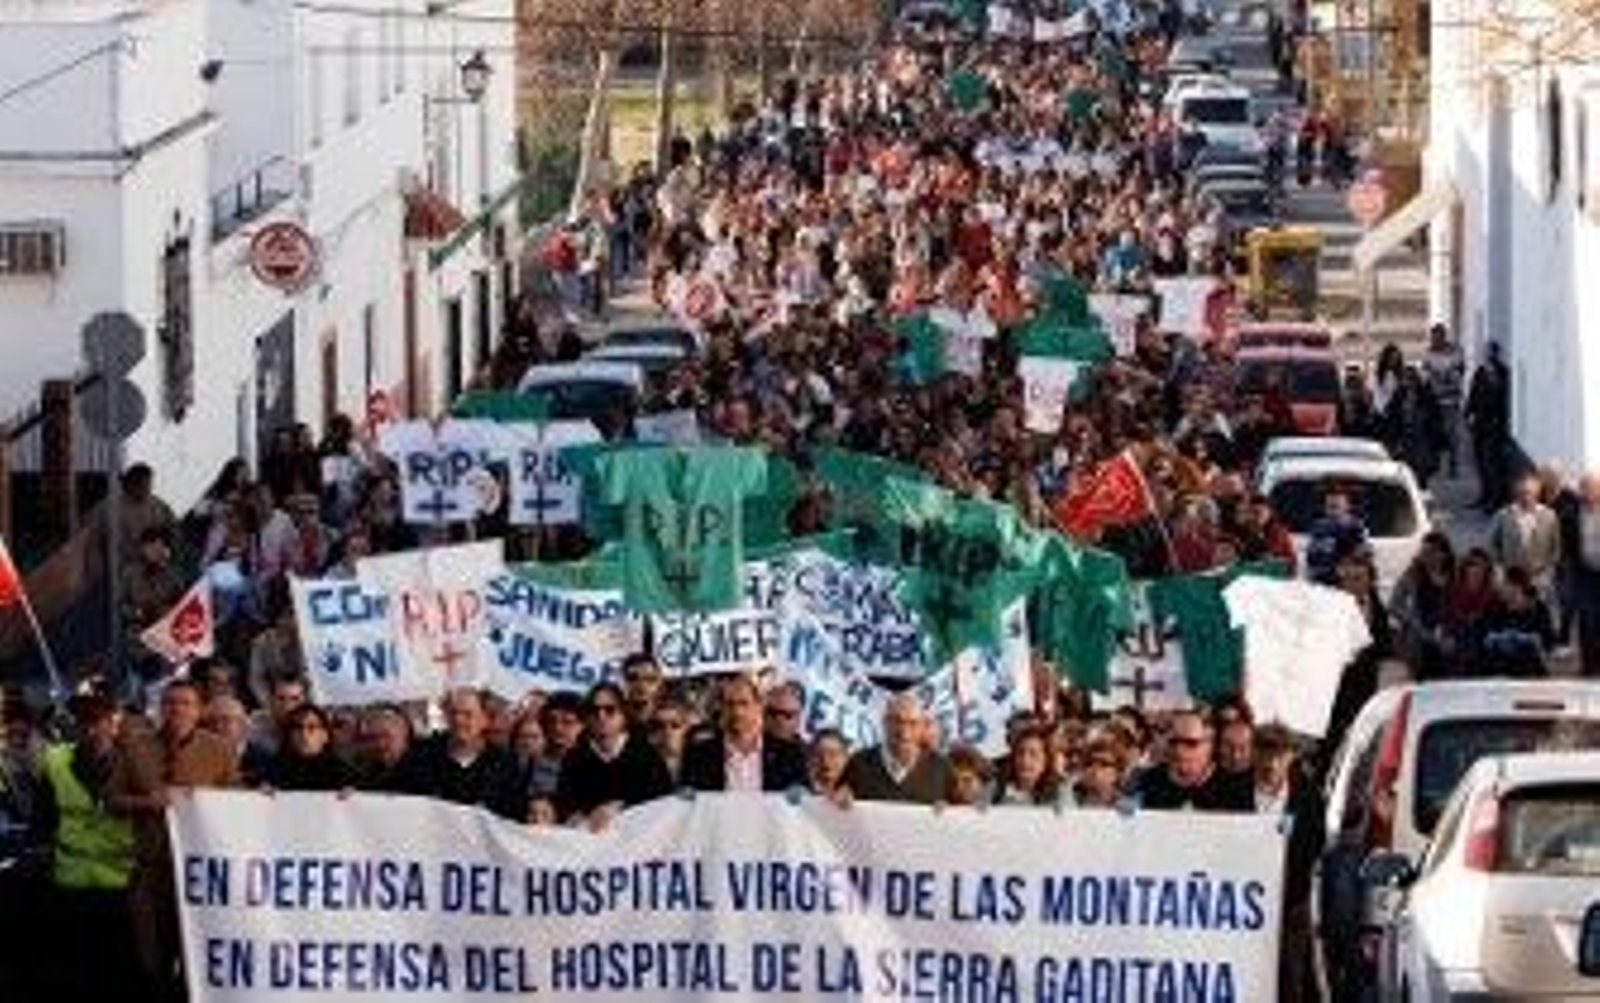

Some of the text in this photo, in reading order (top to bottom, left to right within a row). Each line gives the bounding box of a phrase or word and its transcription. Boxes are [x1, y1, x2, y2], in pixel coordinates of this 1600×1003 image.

[185, 858, 1266, 931] EN DEFENSA DEL HOSPITAL VIRGEN DE LAS MONTAÑAS
[207, 938, 1236, 1003] EN DEFENSA DEL HOSPITAL DE LA SIERRA GADITANA
